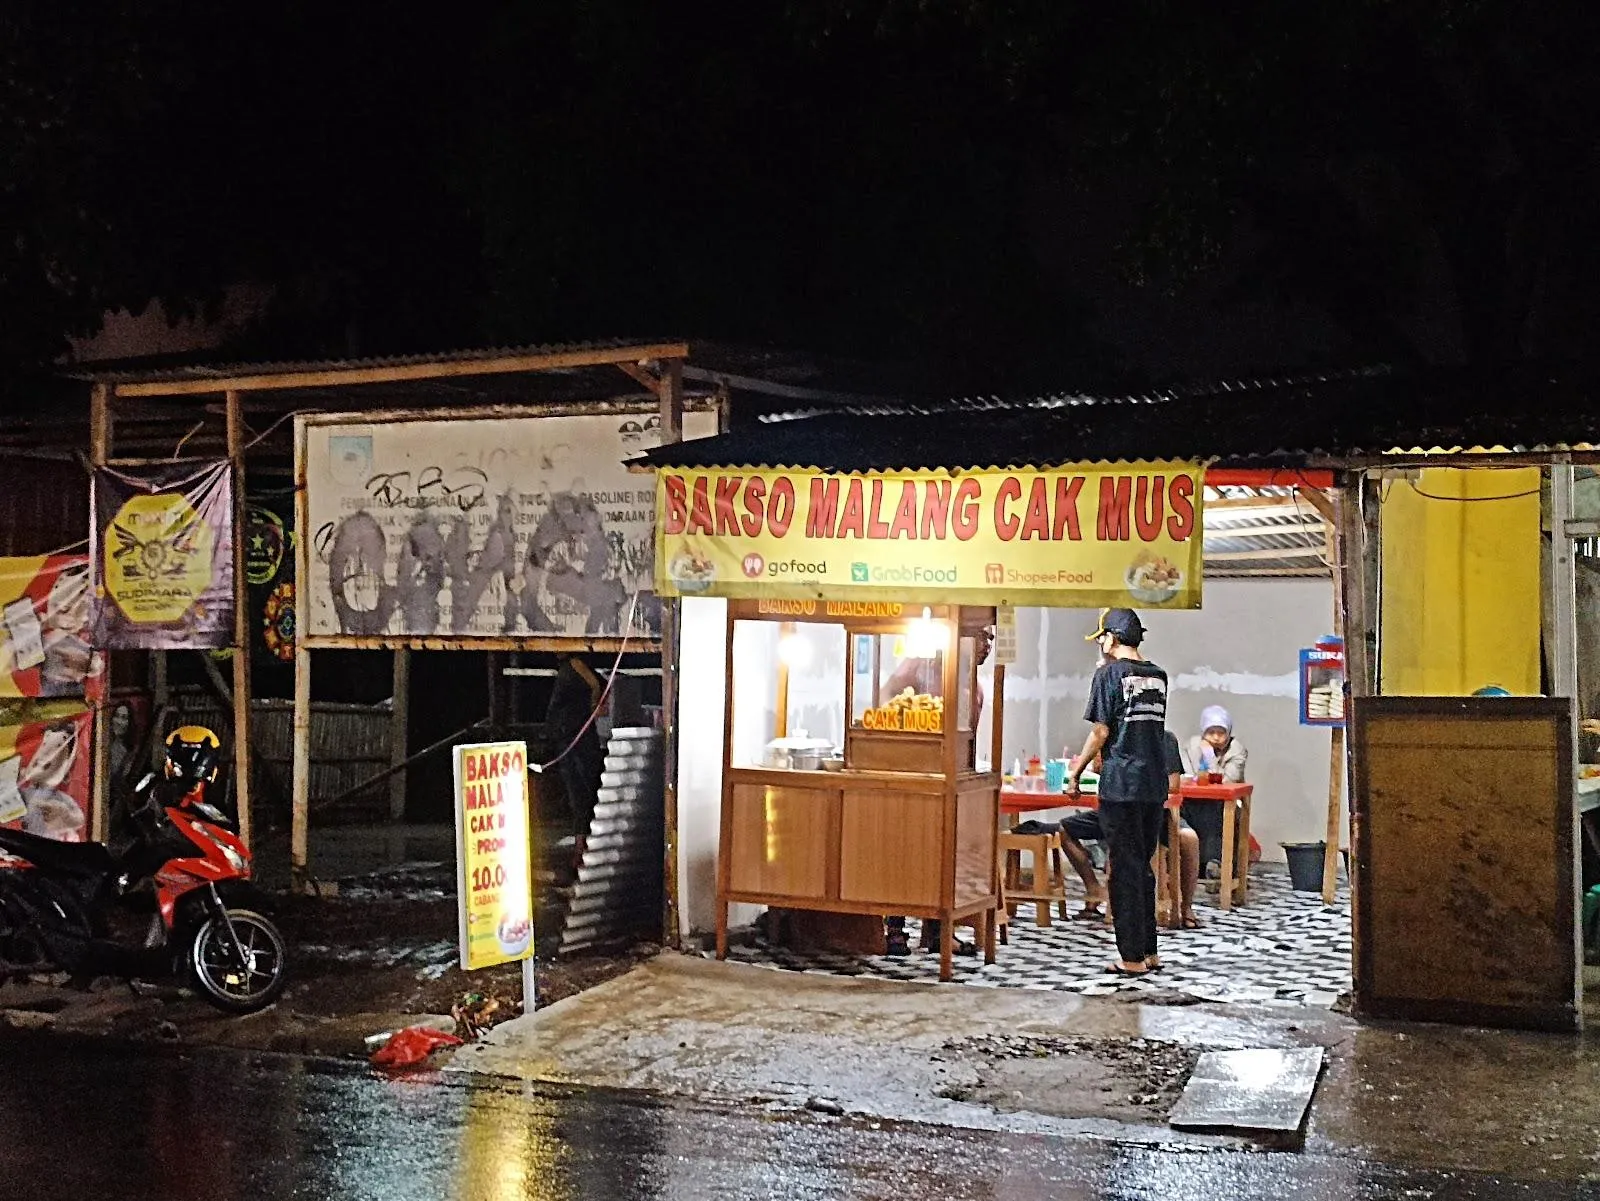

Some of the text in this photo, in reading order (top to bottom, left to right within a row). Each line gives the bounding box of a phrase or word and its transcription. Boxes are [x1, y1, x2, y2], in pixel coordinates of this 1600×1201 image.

[664, 474, 1194, 541] BAKSO MALANG CAK MUS
[767, 559, 827, 577] gofood
[872, 566, 957, 583] GrabFood
[1007, 570, 1093, 585] ShopeeFood
[827, 600, 902, 618] MALANG
[863, 708, 941, 732] CAK MUS
[466, 751, 523, 781] BAKSO
[471, 814, 494, 833] CAK
